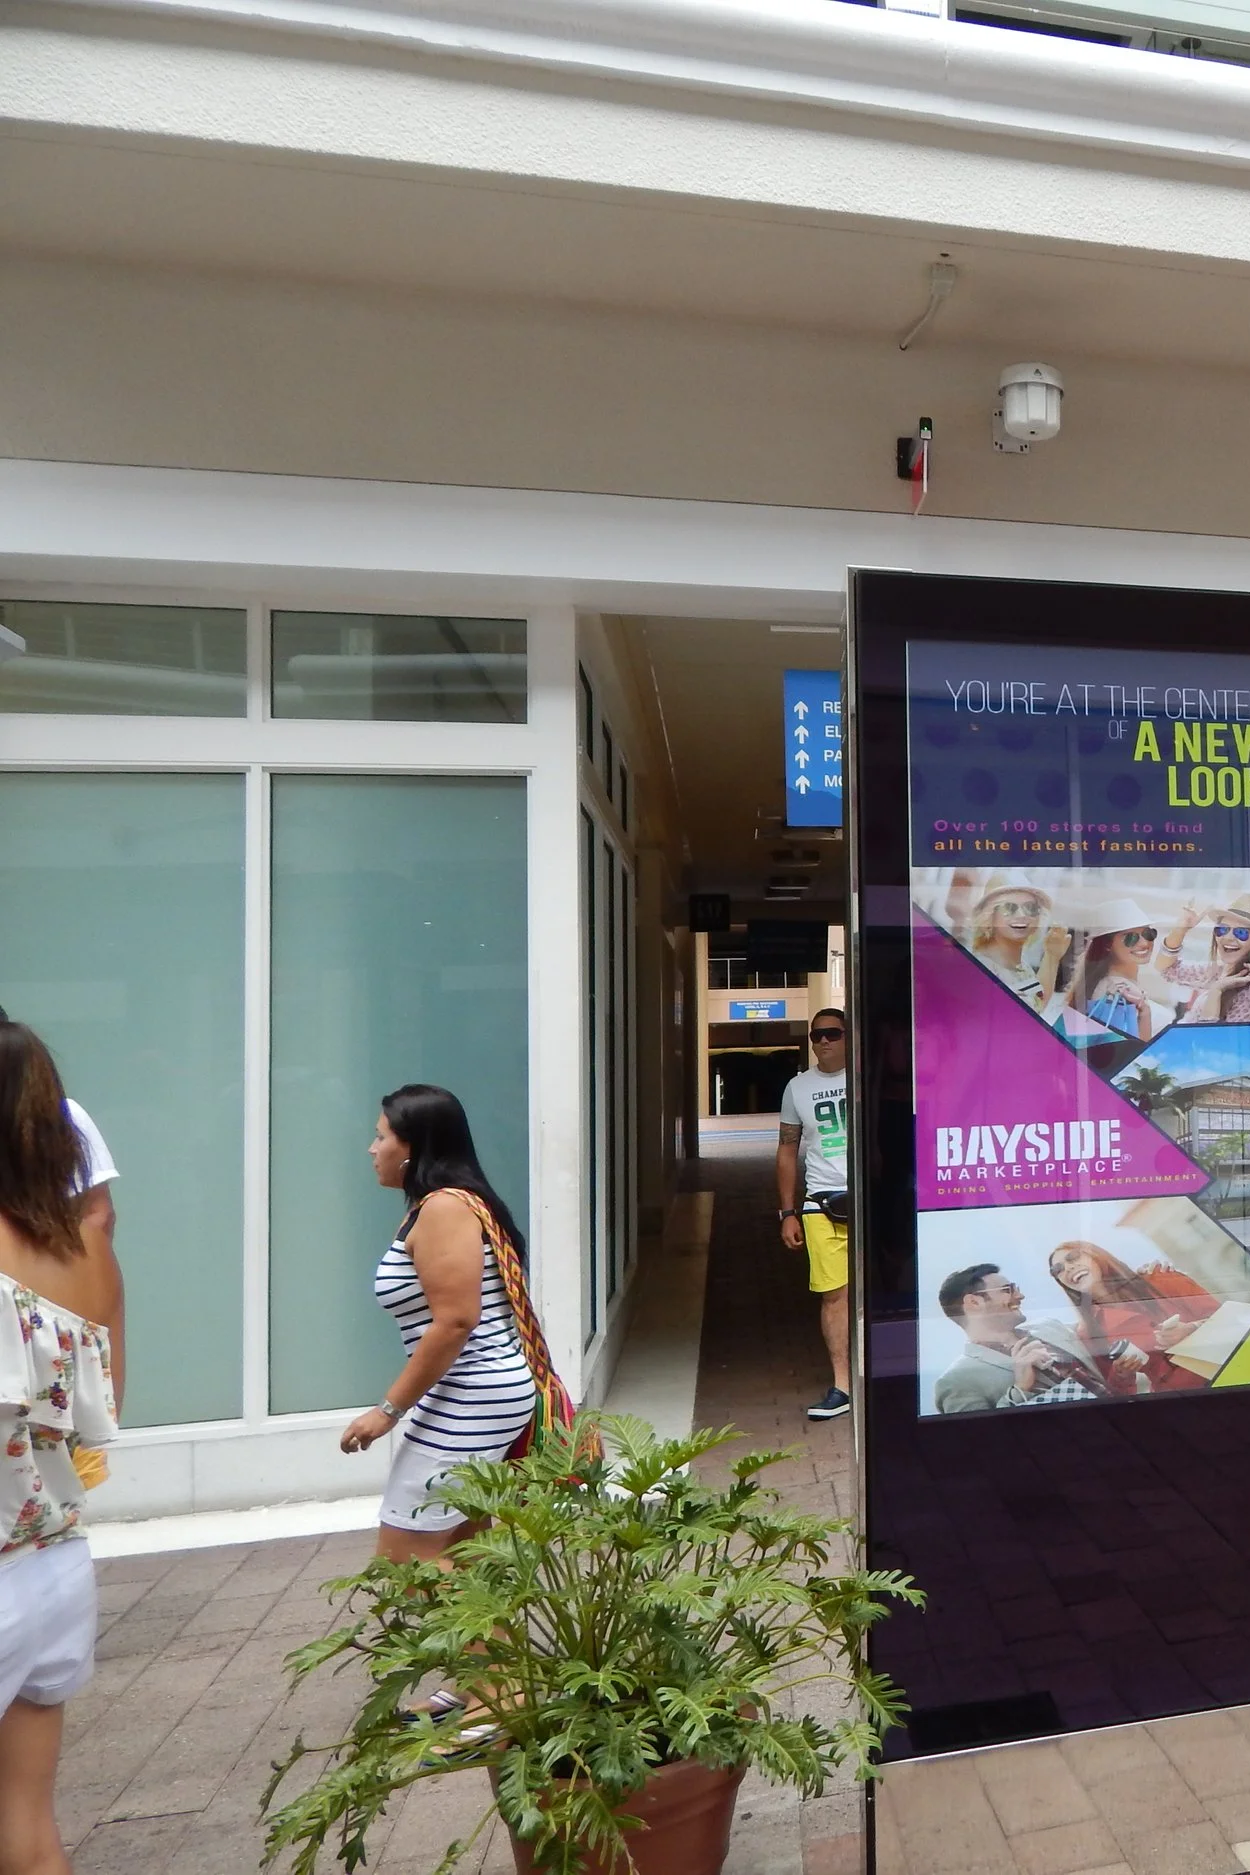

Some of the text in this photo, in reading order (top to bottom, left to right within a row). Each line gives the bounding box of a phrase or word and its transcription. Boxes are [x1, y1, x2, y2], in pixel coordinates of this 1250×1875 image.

[944, 679, 1047, 716] YOU'RE
[1055, 684, 1096, 716] AT
[1103, 685, 1157, 719] THE
[1108, 720, 1129, 740] OF
[1133, 721, 1161, 761] A
[934, 819, 1203, 834] Over 100 stores to find
[934, 839, 1203, 852] all the latest fashions.
[936, 1119, 1121, 1167] BAYSIDE
[936, 1159, 1122, 1181] MARKETPLACE
[938, 1173, 1199, 1195] DINING SHOPPING ENTERTAINMENT
